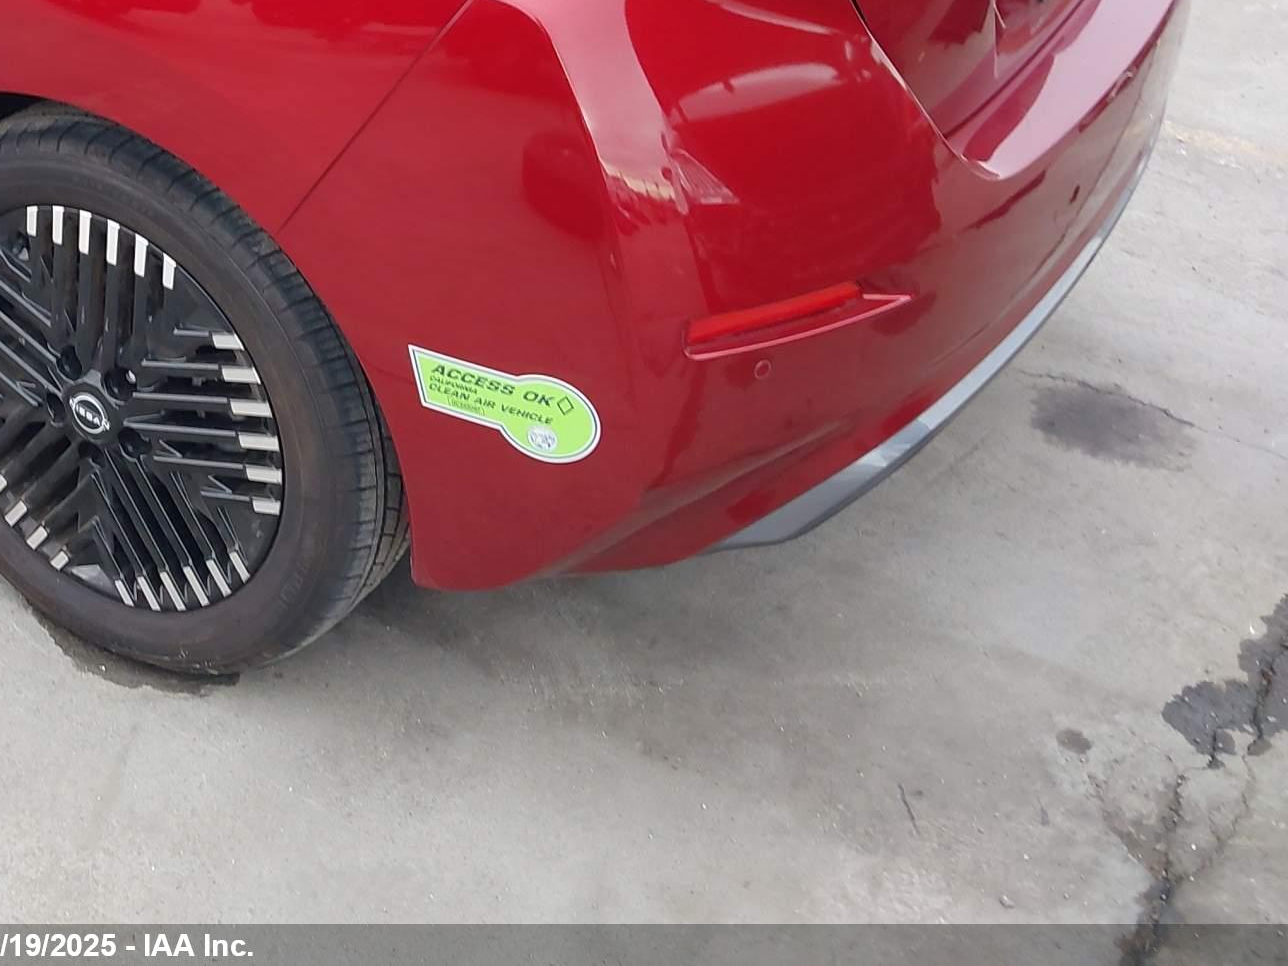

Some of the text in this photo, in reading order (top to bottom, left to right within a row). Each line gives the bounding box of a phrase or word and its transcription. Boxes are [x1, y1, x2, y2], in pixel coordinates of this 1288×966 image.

[429, 383, 470, 401] CLEAN
[474, 397, 496, 409] AIR
[501, 404, 553, 424] VEHICLE
[431, 364, 555, 408] ACCESS OK
